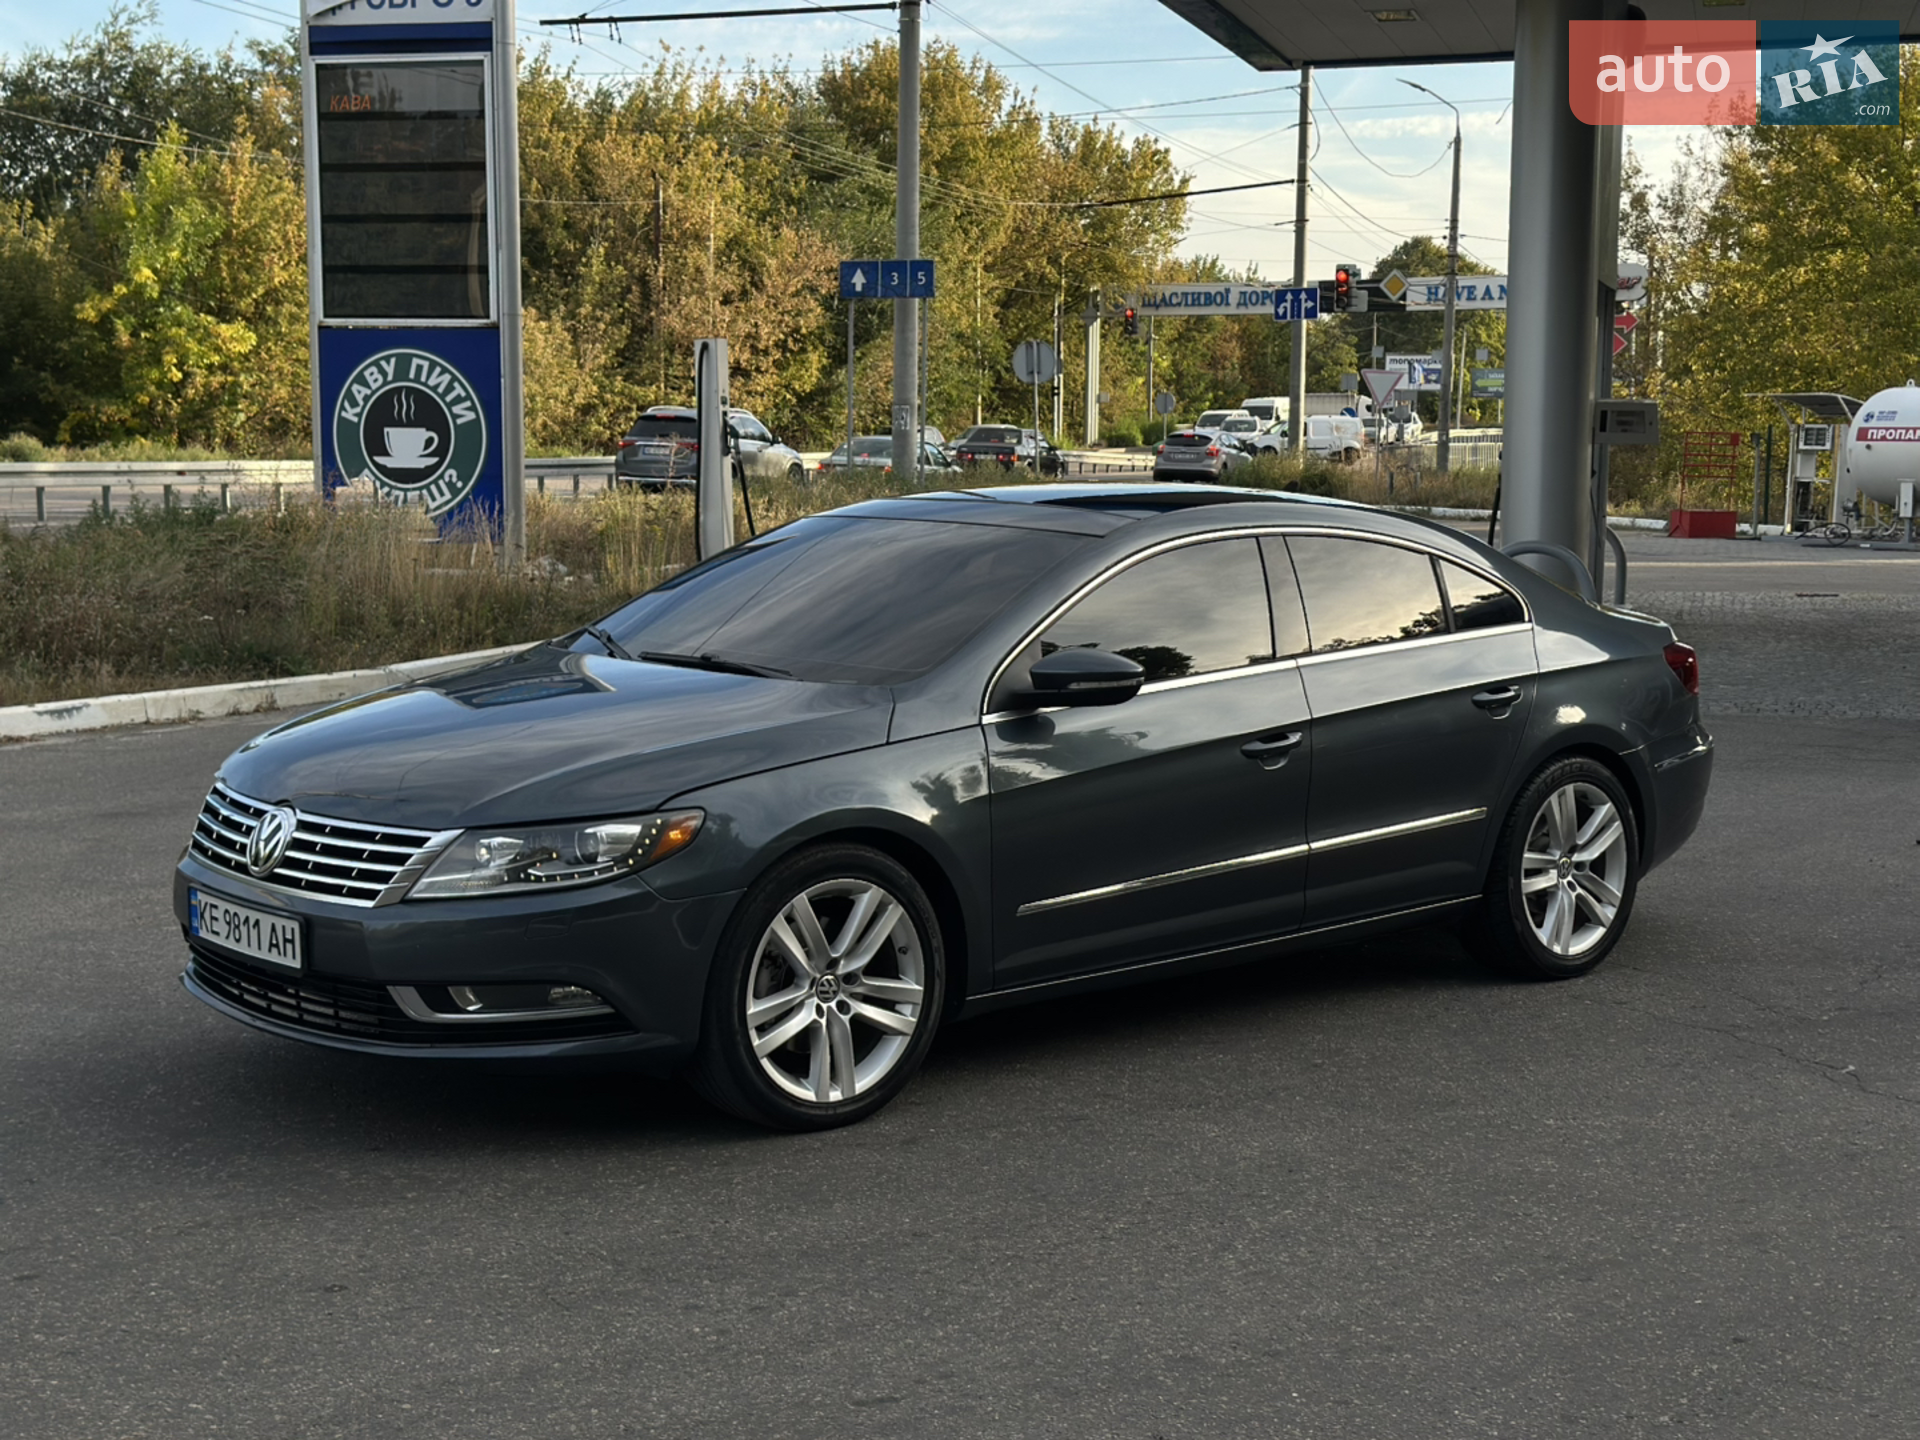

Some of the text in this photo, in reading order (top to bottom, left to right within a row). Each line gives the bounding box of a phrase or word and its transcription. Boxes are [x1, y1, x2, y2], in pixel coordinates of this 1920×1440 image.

[330, 95, 372, 111] КАВА
[890, 272, 899, 285] 3
[917, 271, 926, 285] 5
[1426, 284, 1477, 302] HVE
[341, 357, 477, 425] КАВУ ПИТИ
[1867, 428, 1920, 440] ПРОПА
[198, 899, 297, 961] KE 9811 AH
